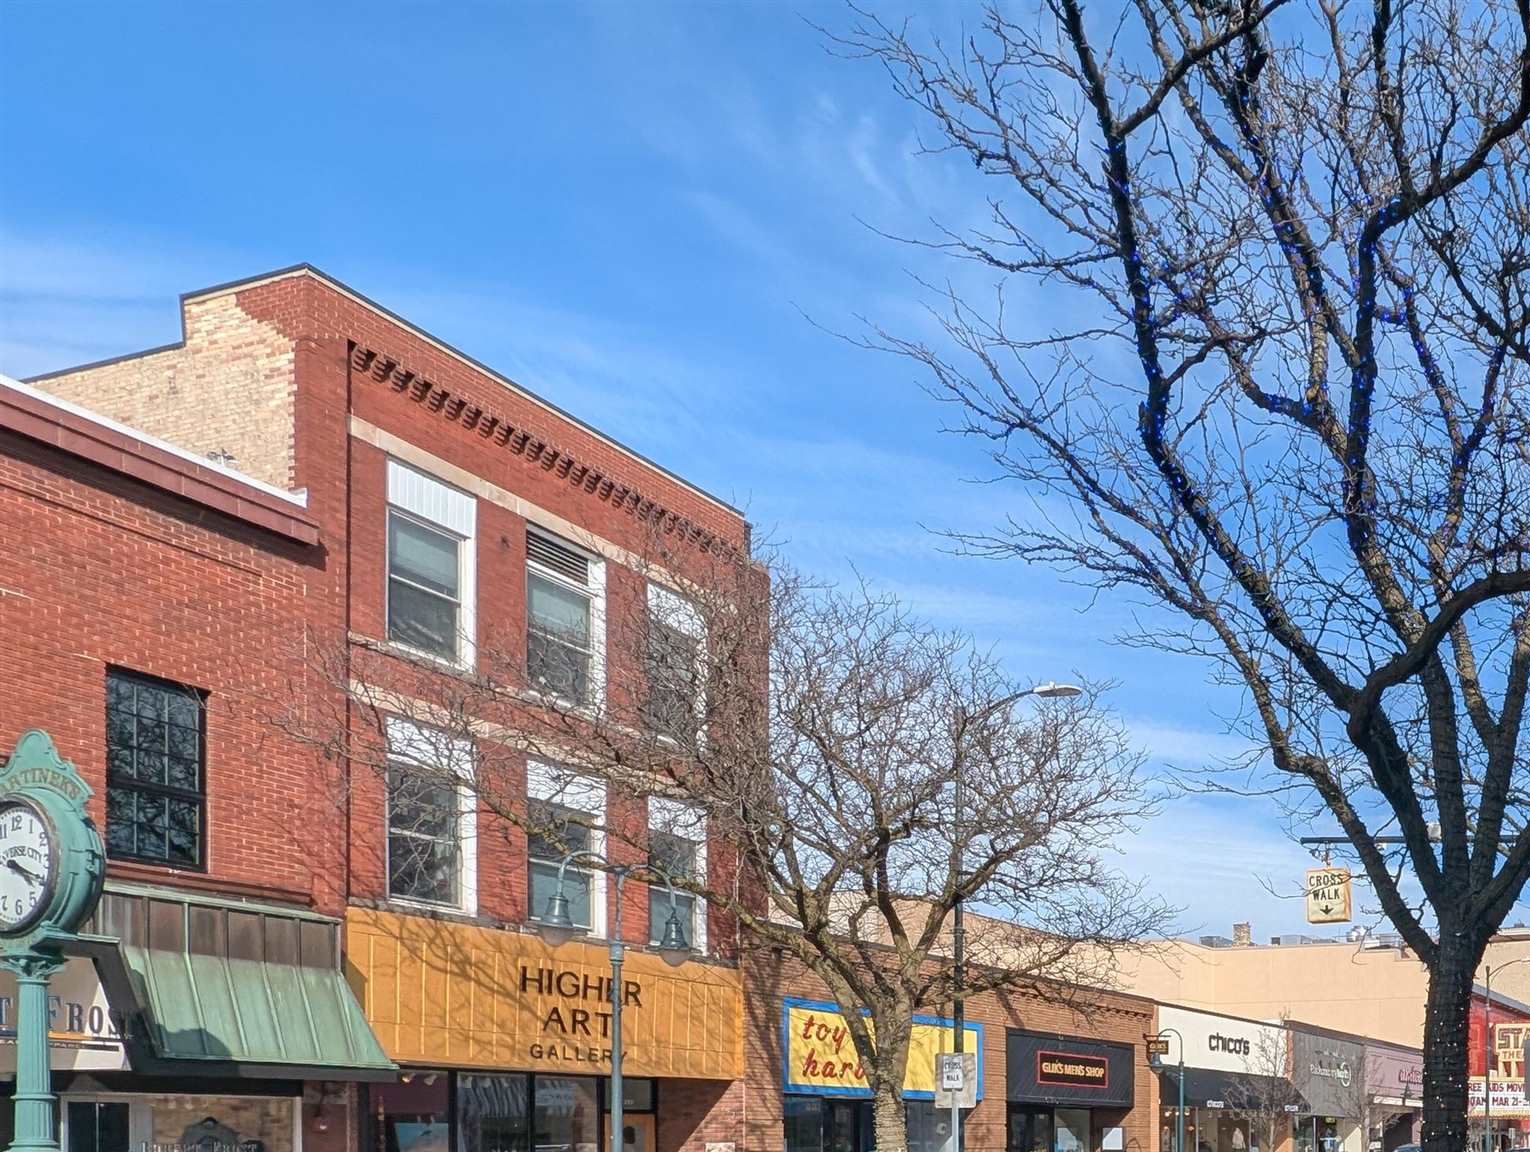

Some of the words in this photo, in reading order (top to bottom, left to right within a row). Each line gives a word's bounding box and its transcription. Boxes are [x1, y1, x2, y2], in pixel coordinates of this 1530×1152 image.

[1309, 872, 1343, 886] CROSS
[1312, 888, 1340, 901] WALK
[543, 1006, 613, 1038] ART
[802, 1015, 849, 1055] toy
[1208, 1032, 1250, 1056] chico's
[1468, 1083, 1482, 1092] REE
